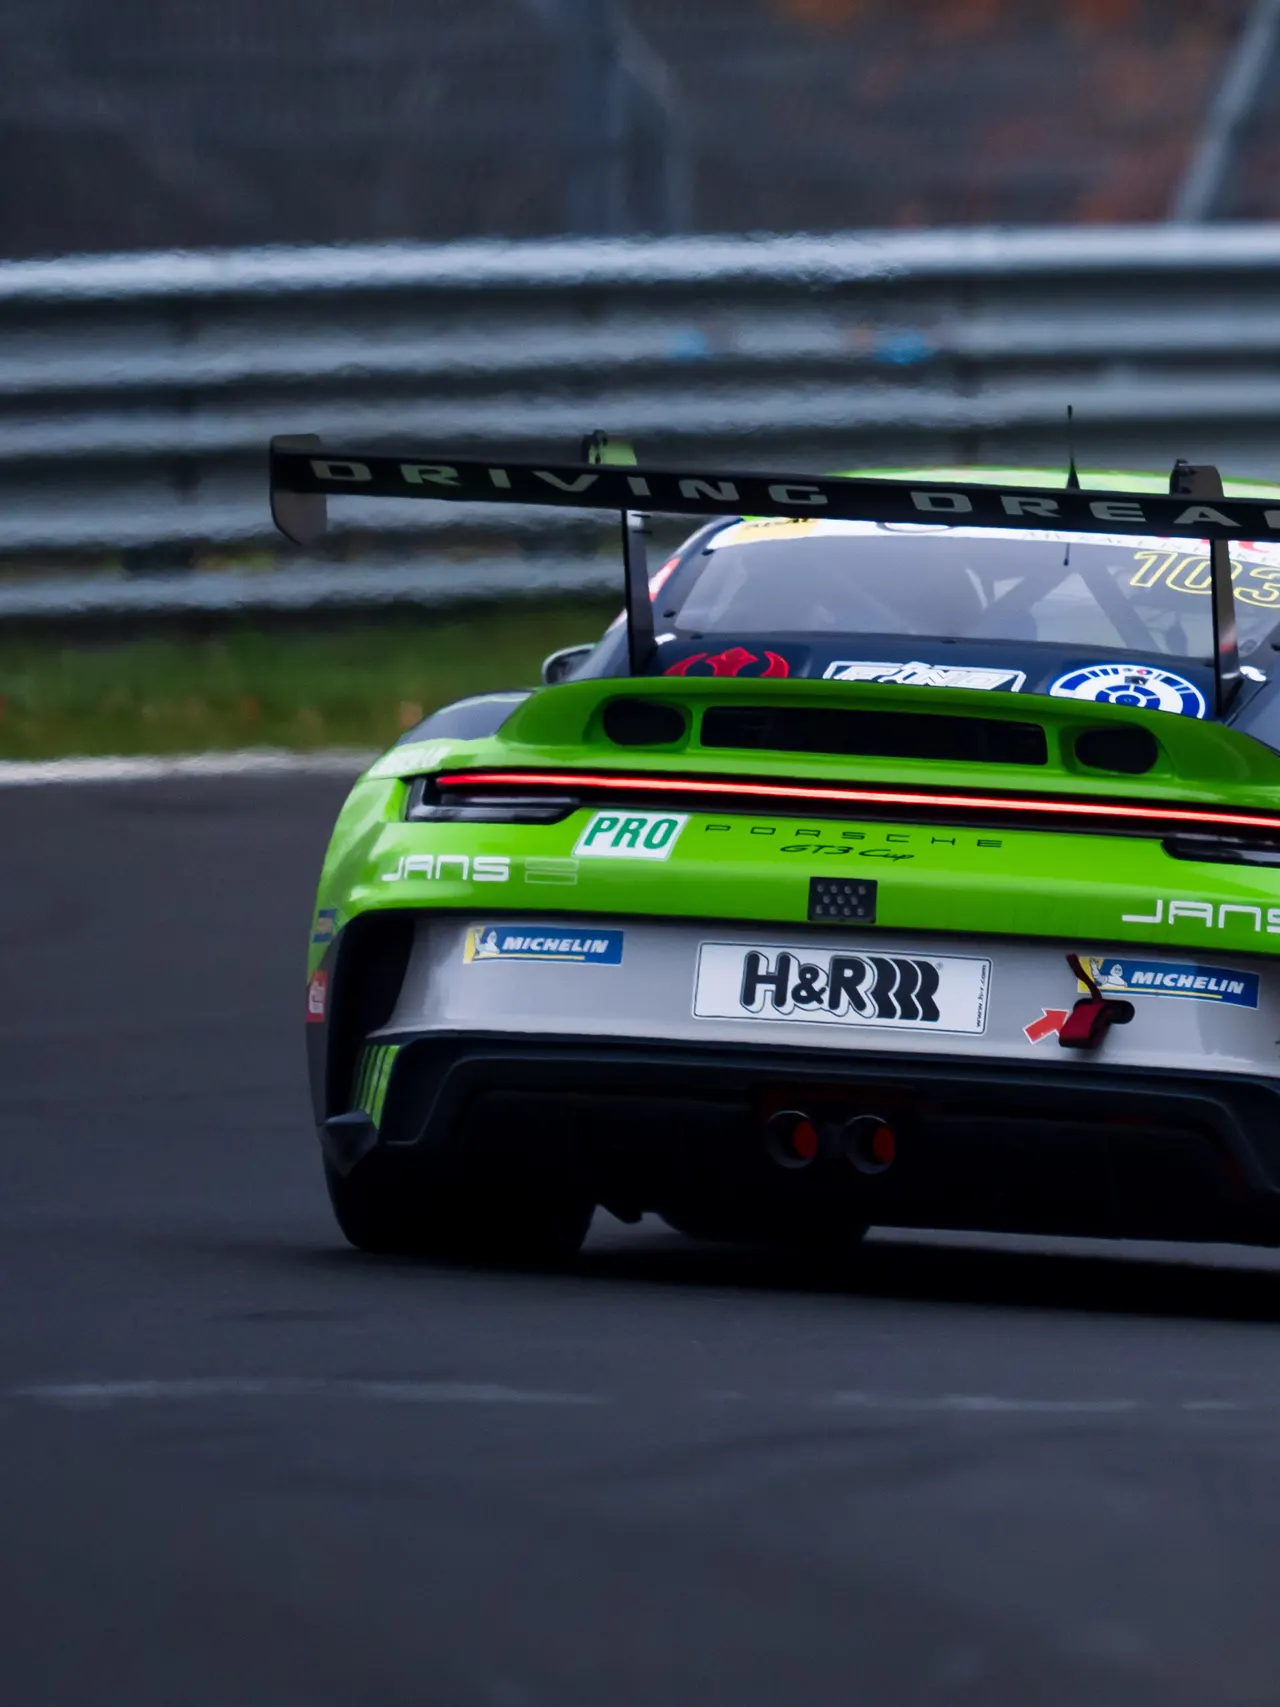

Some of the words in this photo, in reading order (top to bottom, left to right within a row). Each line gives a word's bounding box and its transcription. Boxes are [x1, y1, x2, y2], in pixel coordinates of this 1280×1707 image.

[310, 460, 828, 505] DRIVING
[583, 817, 679, 850] PRO
[705, 824, 1003, 848] PORSCHE
[780, 844, 854, 855] GT3
[858, 848, 915, 861] Cup
[381, 854, 511, 881] JANS
[502, 937, 609, 953] MICHELIN
[1131, 971, 1245, 994] MICHELIN
